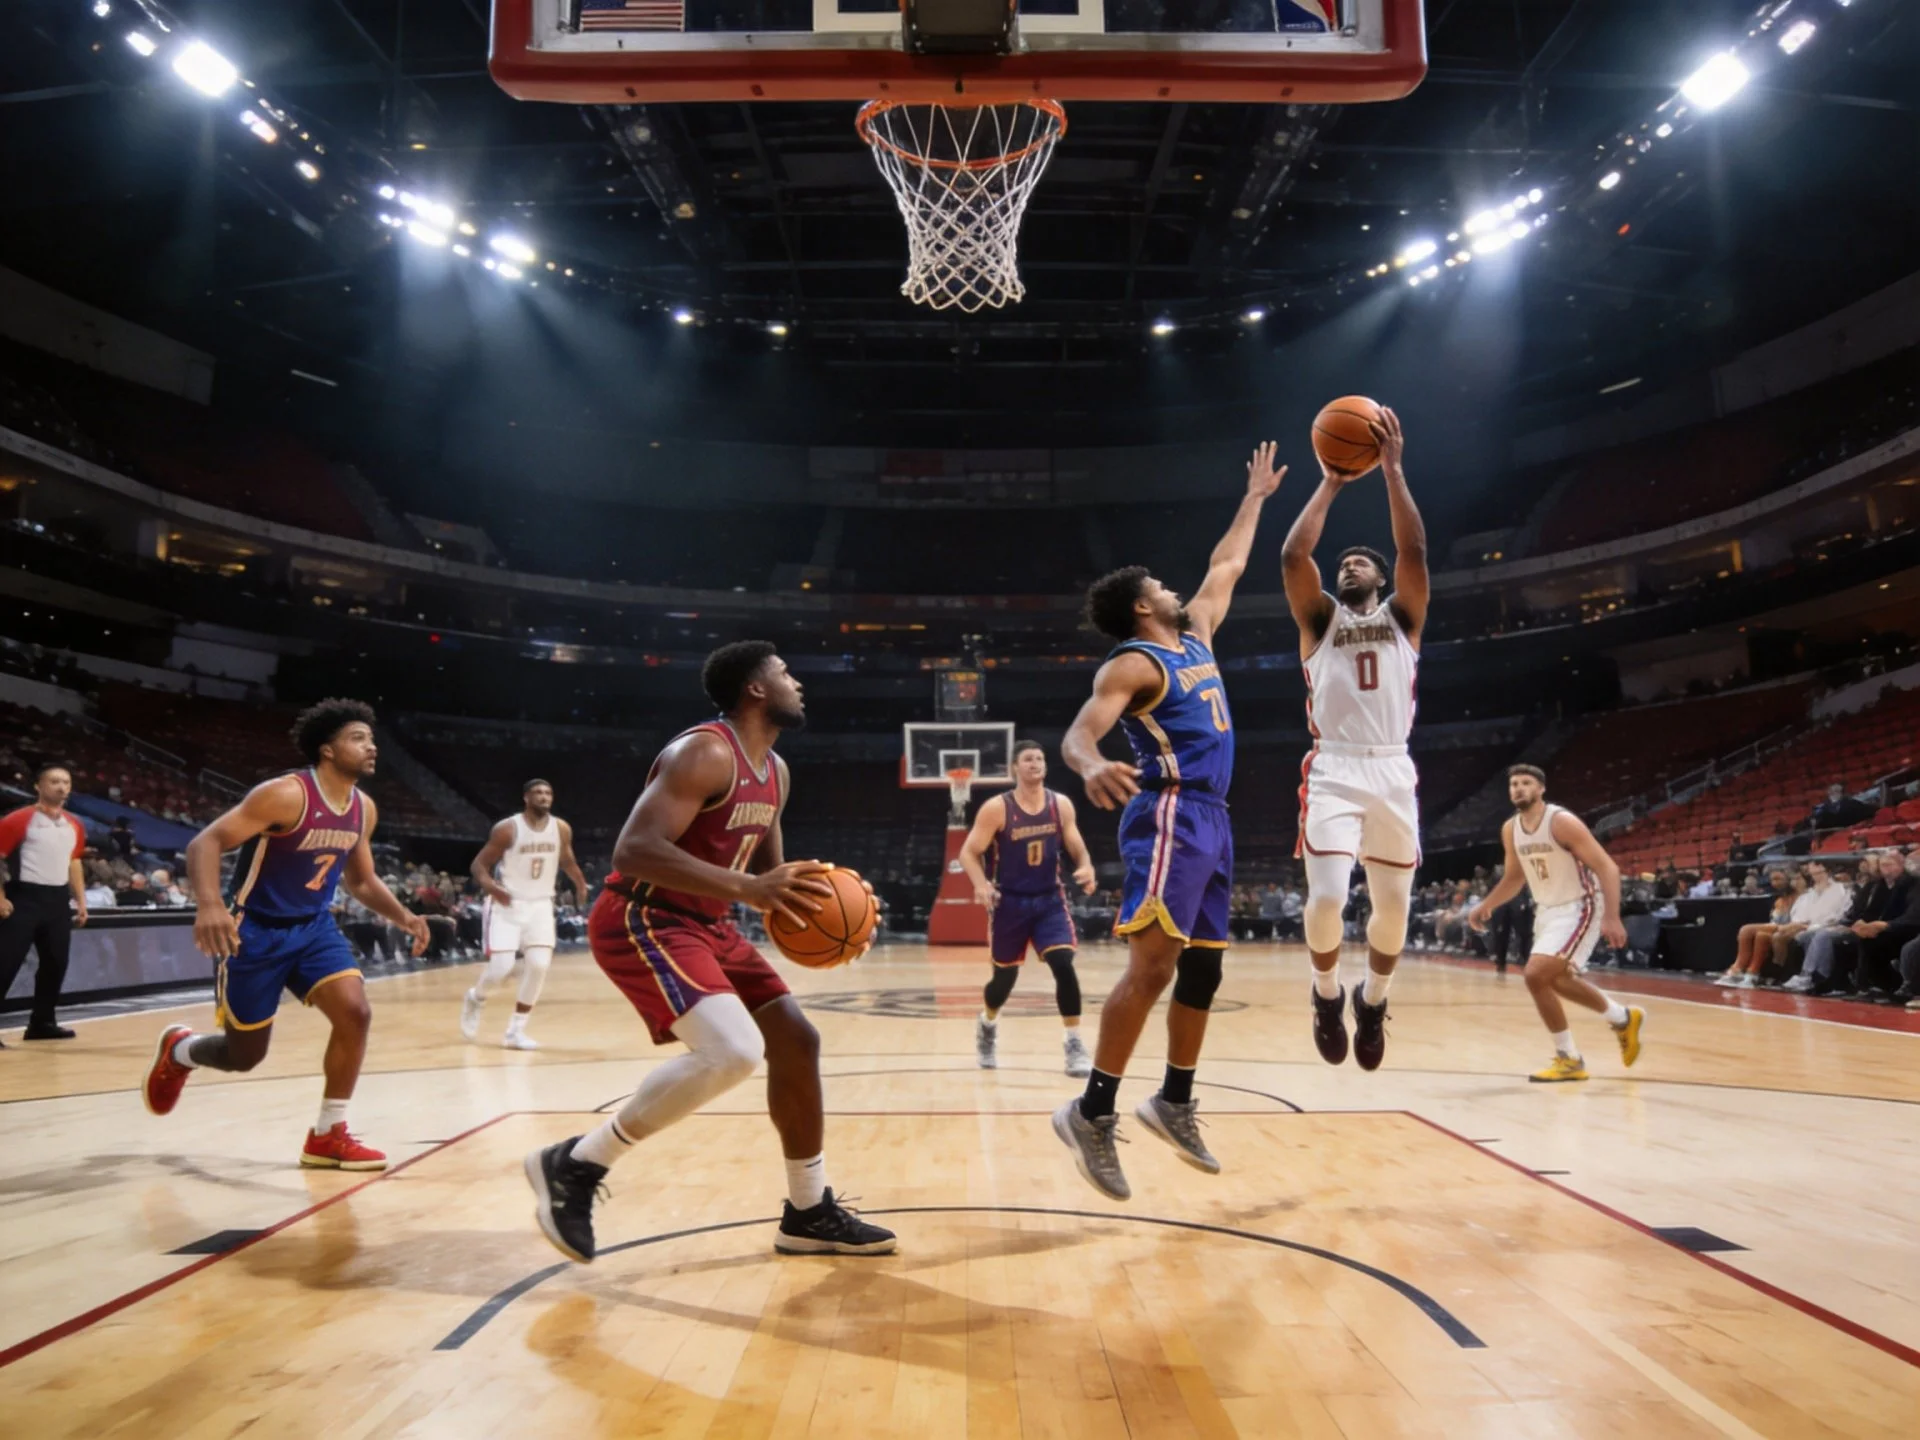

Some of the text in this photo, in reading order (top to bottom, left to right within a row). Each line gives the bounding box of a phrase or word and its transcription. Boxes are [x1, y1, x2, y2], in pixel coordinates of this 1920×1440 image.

[1355, 650, 1379, 692] 0
[304, 854, 338, 891] 7
[1027, 841, 1044, 867] 0
